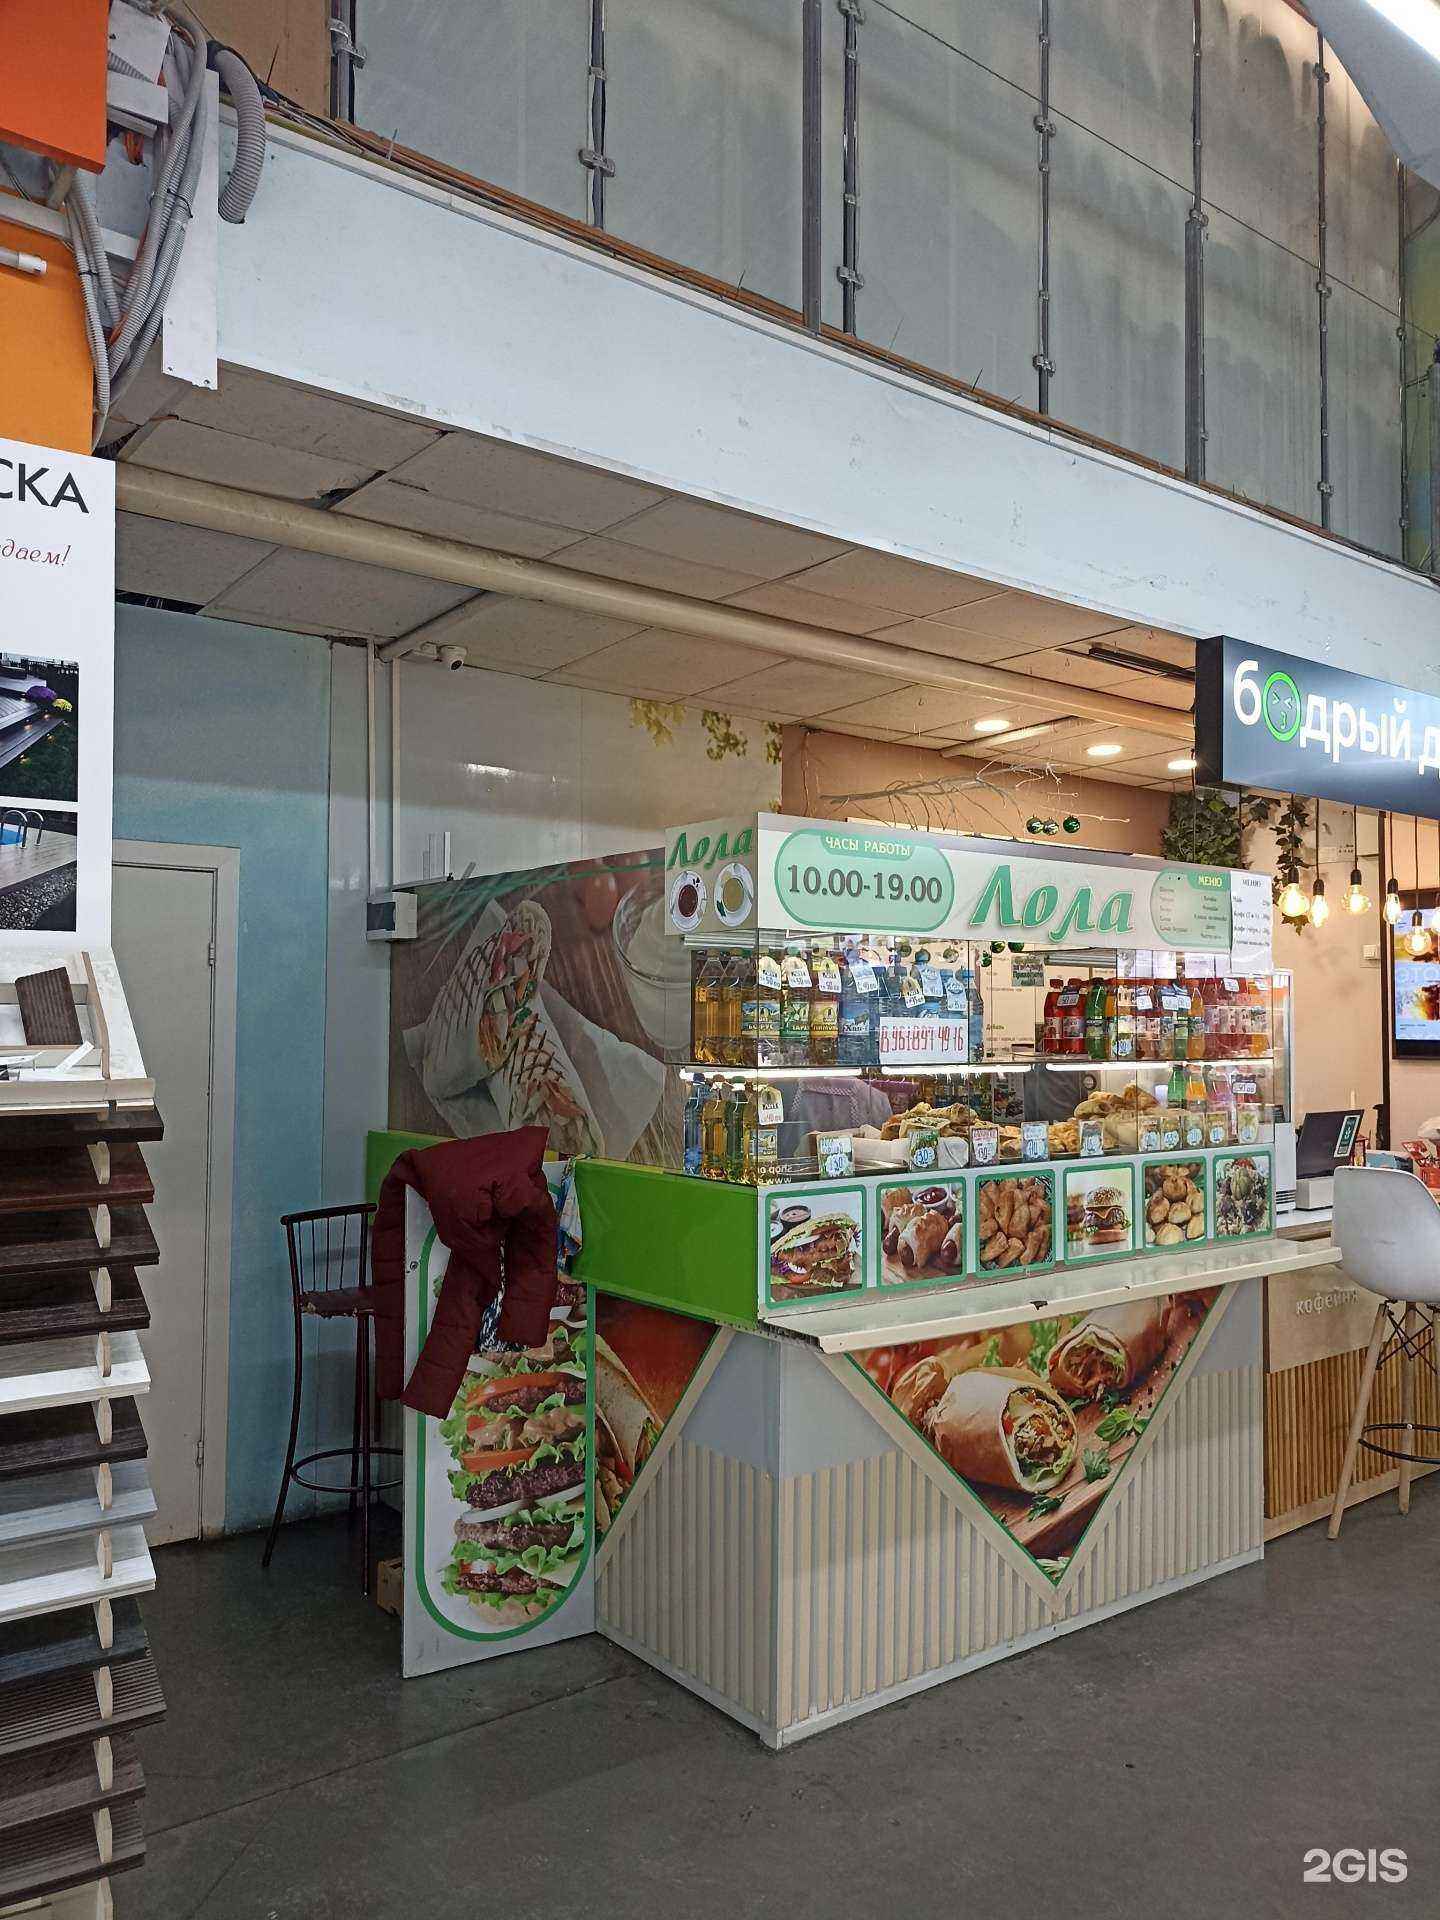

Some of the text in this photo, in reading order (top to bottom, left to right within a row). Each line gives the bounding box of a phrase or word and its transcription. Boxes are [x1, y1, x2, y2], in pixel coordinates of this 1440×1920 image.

[0, 538, 72, 567] даем!
[667, 829, 755, 870] Лола
[825, 836, 911, 856] ЧАСЫ РАБОТЫ
[787, 864, 943, 905] 10.00-19.00
[1198, 875, 1223, 887] МЕНЮ
[969, 864, 1135, 944] Лола
